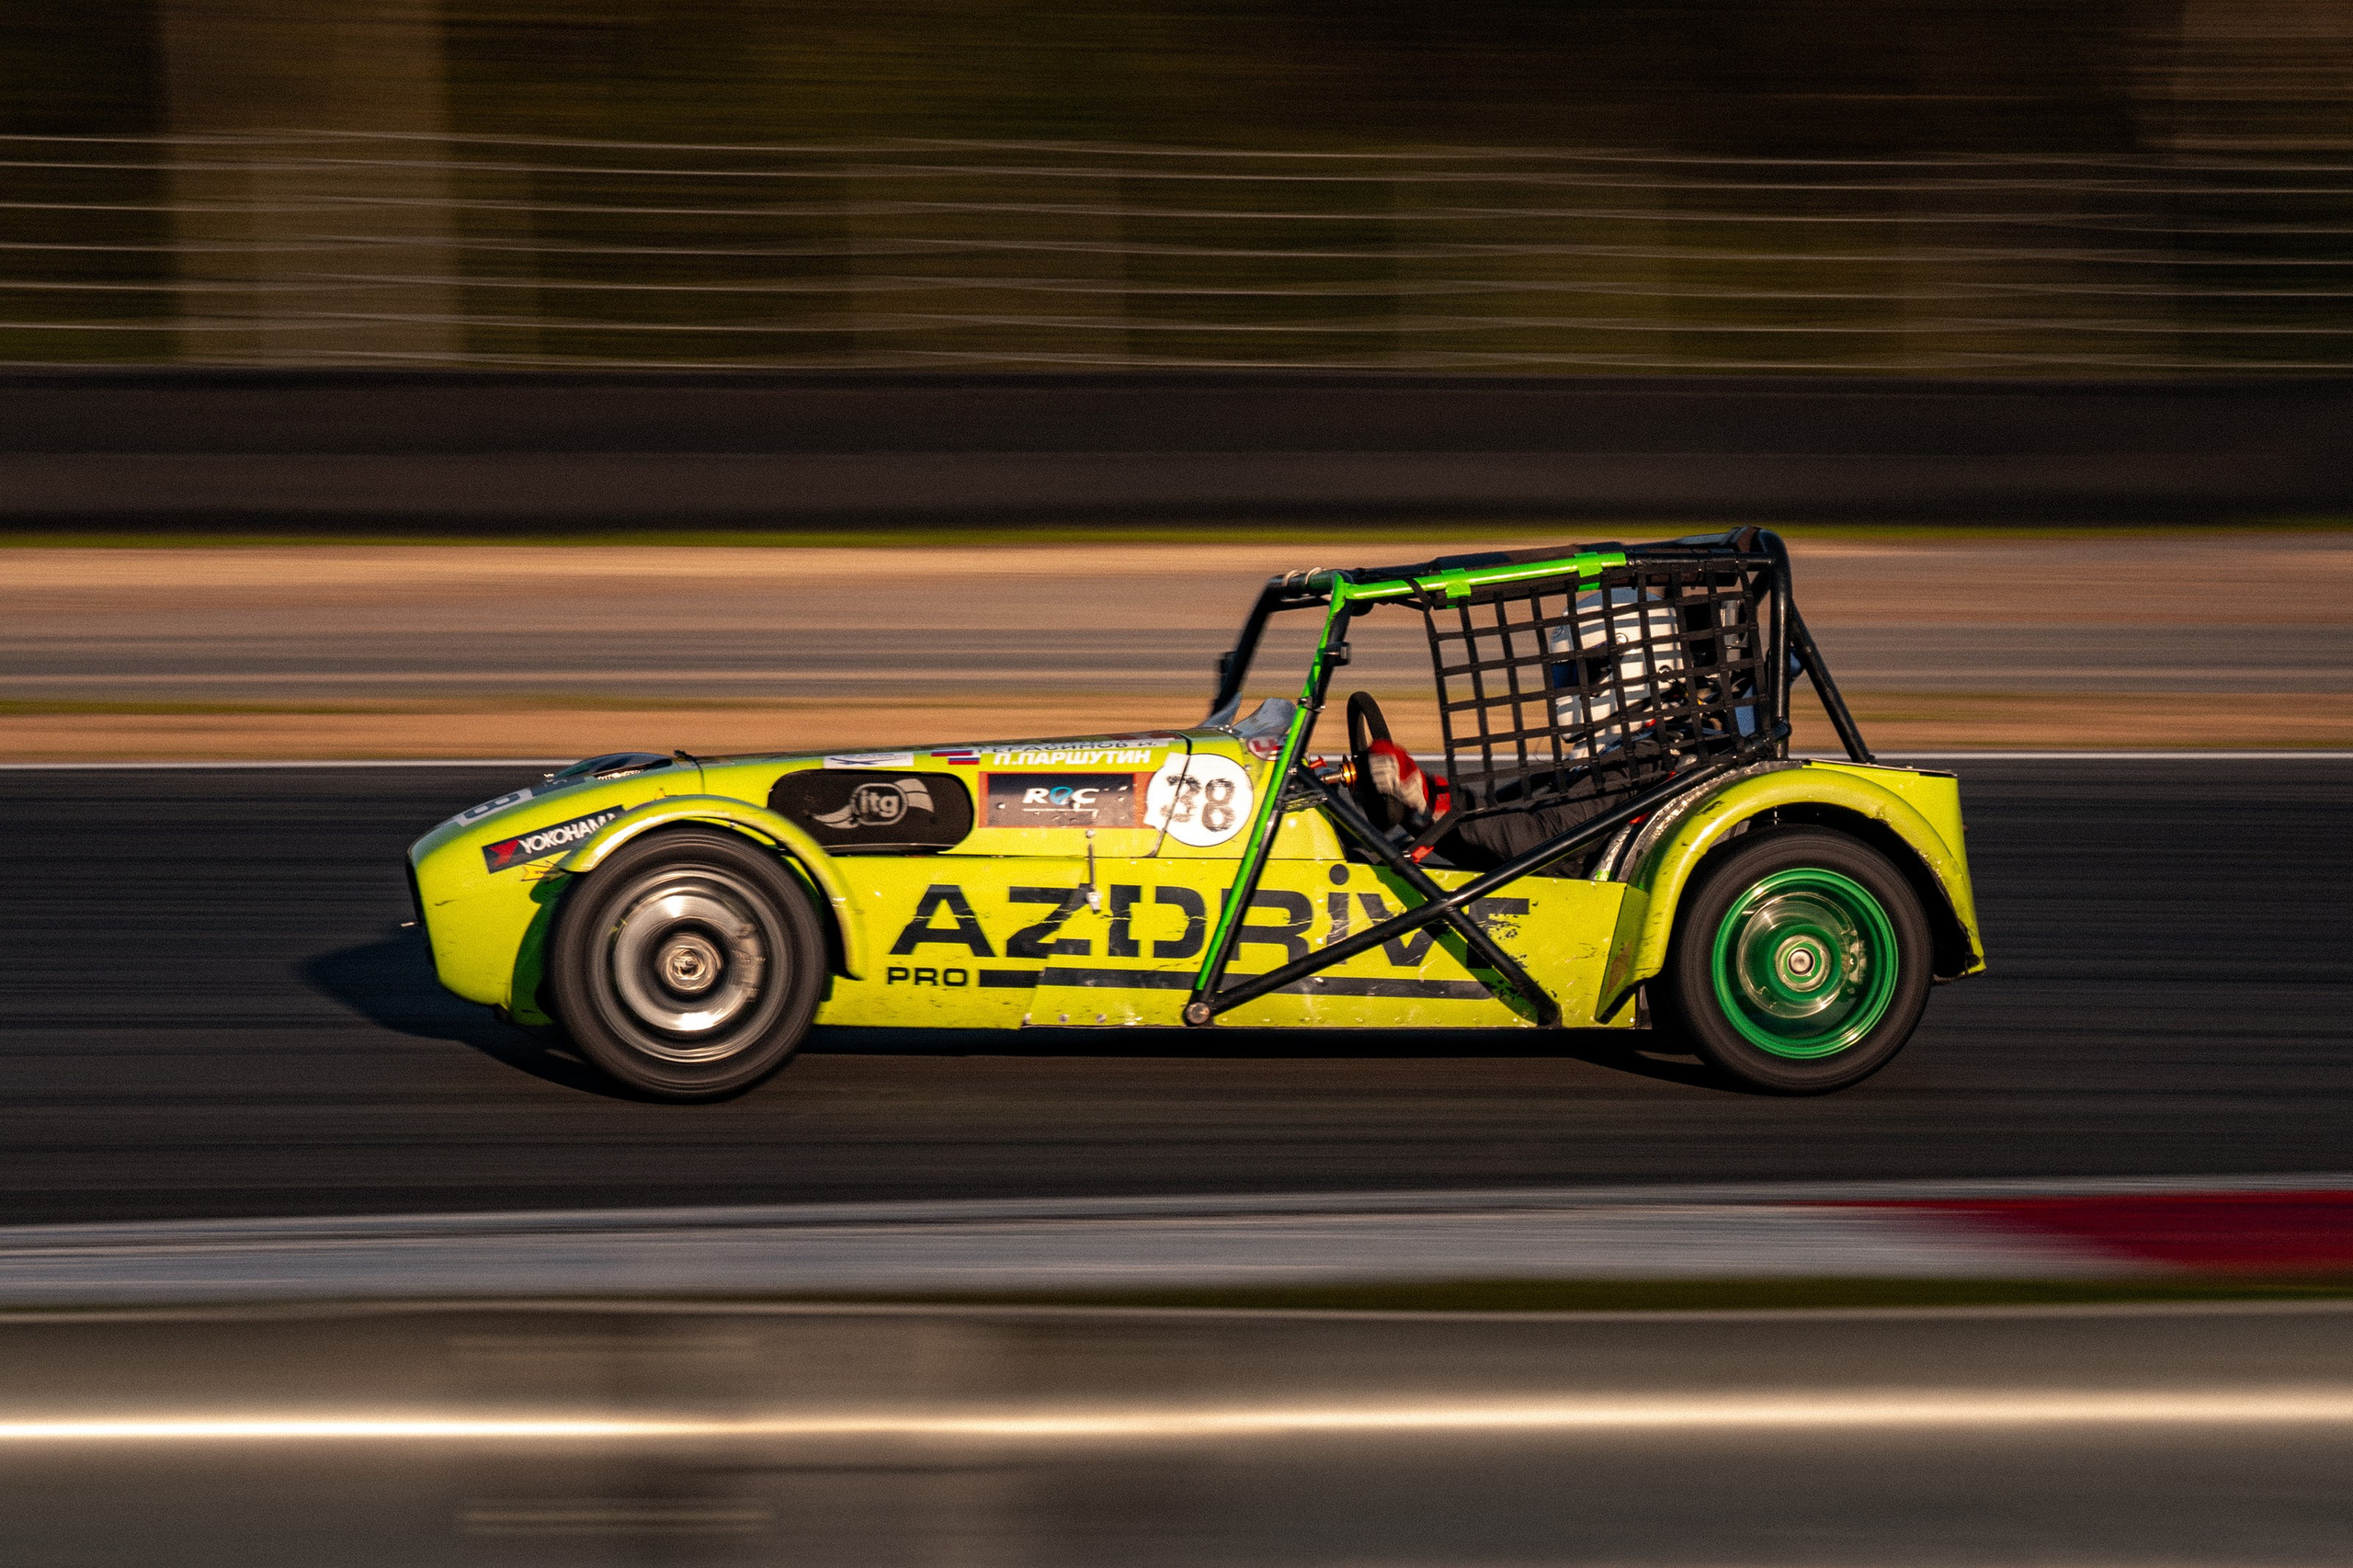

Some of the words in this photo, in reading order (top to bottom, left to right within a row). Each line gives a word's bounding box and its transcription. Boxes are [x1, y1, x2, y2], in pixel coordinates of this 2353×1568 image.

[993, 749, 1152, 766] П.ПАРШУТИН
[859, 790, 899, 818] itg
[1160, 774, 1236, 832] 38
[887, 966, 969, 987] PRO
